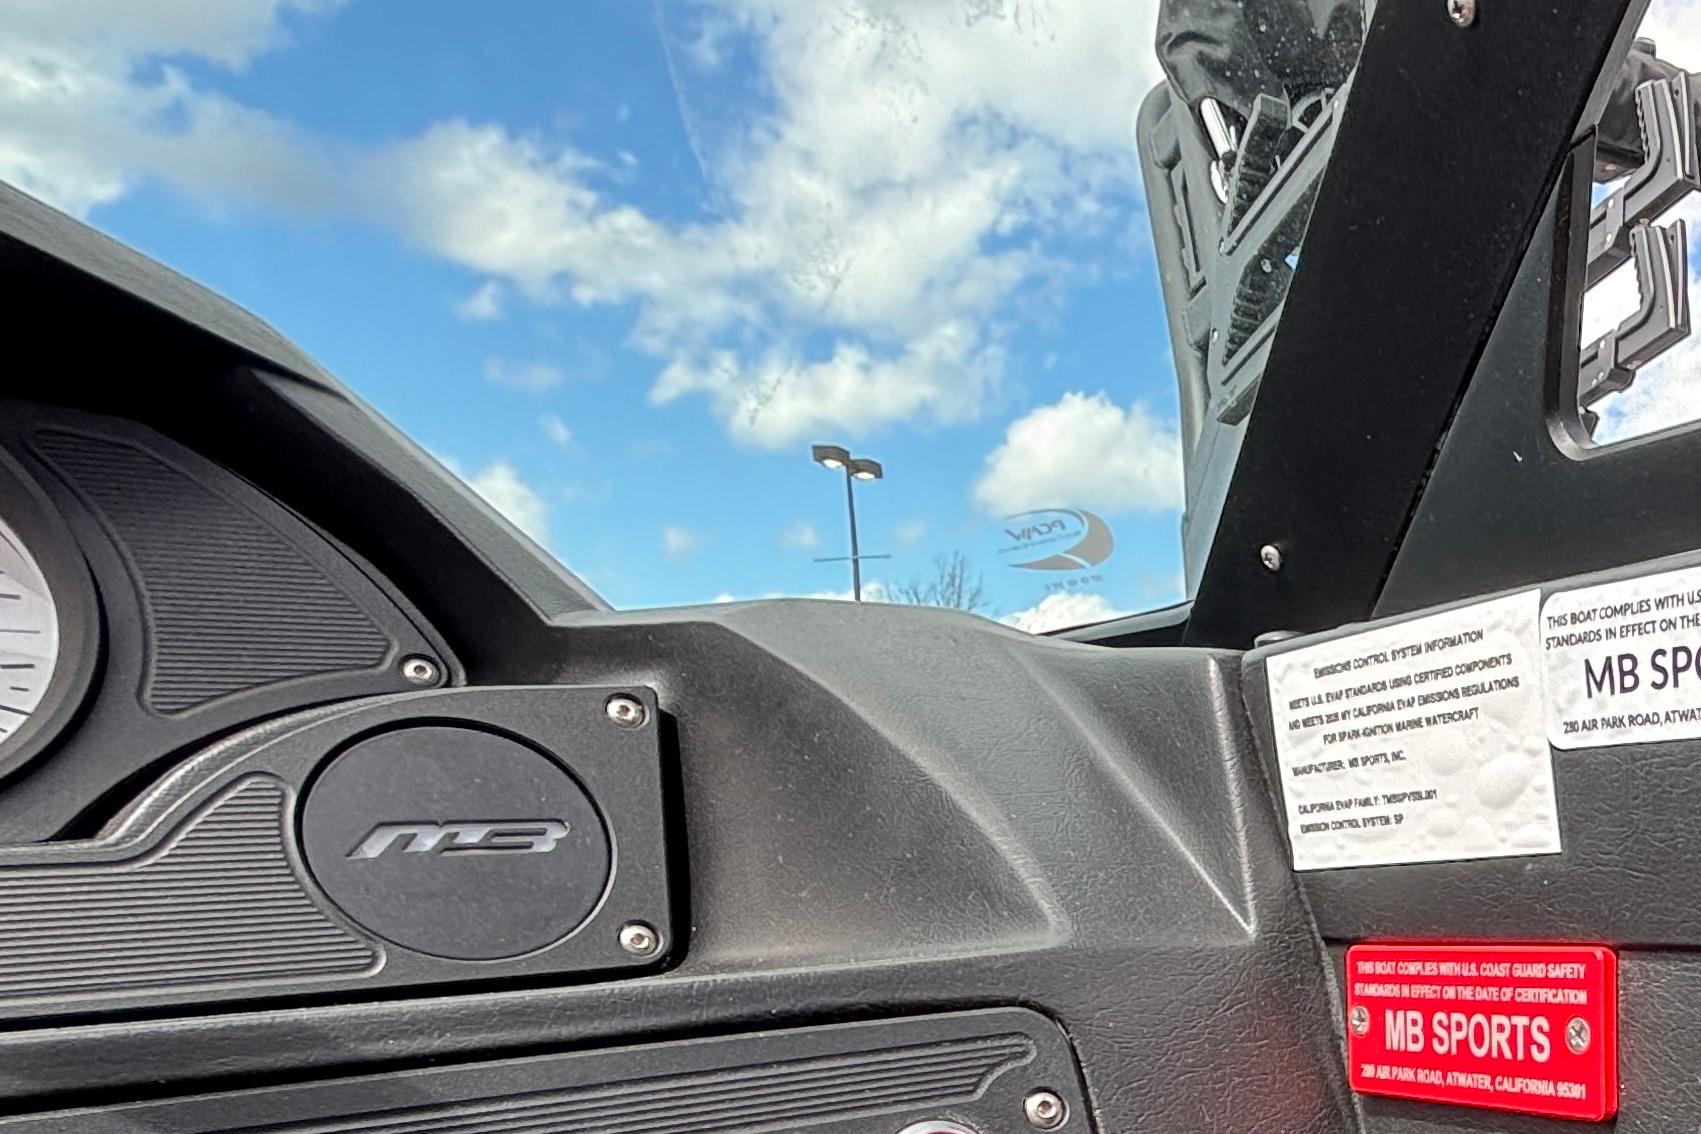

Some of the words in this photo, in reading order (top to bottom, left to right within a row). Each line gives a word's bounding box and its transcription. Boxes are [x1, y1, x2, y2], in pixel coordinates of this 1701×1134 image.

[1547, 613, 1568, 629] THIS
[1570, 608, 1598, 624] BOAT
[1599, 599, 1651, 620] COMPLIES
[1655, 593, 1684, 611] WITH
[1353, 651, 1389, 669] CONTROL
[1391, 643, 1422, 661] SYSTEM
[1424, 629, 1484, 653] INFORMATION
[1546, 629, 1602, 650] STANDARDS
[1605, 627, 1617, 640] IN
[1619, 620, 1657, 639] EFFECT
[1659, 616, 1677, 633] ON
[1679, 612, 1701, 629] THE
[1325, 689, 1344, 703] EVAP
[1345, 680, 1387, 699] STANDARDS
[1389, 675, 1412, 690] USING
[1414, 666, 1453, 684] CERTIFIED
[1455, 653, 1512, 676] COMPONENTS
[1584, 652, 1640, 699] MB
[1353, 701, 1395, 718] CALIFORNIA
[1397, 696, 1415, 710] EVAP
[1418, 688, 1460, 706] EMISSIONS
[1461, 676, 1519, 697] REGULATIONS
[1323, 733, 1336, 745] FOR
[1425, 707, 1479, 726] WATERCRAFT
[1581, 717, 1599, 732] AIR
[1601, 714, 1626, 730] PARK
[1628, 711, 1663, 728] ROAD,
[1331, 819, 1361, 831] CONTROL
[1375, 961, 1397, 975] BOAT
[1397, 961, 1438, 976] COMPLIES
[1438, 961, 1461, 976] WITH
[1480, 962, 1512, 977] COAST
[1512, 963, 1546, 978] GUARD
[1547, 963, 1586, 979] SAFETY
[1354, 982, 1400, 997] STANDARDS
[1410, 984, 1442, 999] EFFECT
[1442, 985, 1457, 999] ON
[1457, 985, 1475, 1000] THE
[1475, 986, 1500, 1001] DATE
[1500, 986, 1514, 1002] OF
[1514, 987, 1588, 1005] CERTIFICATION
[1384, 1008, 1424, 1053] MB
[1431, 1011, 1551, 1063] SPORTS
[1376, 1065, 1391, 1080] AIR
[1391, 1066, 1416, 1082] PARK
[1417, 1068, 1445, 1088] ROAD,
[1446, 1071, 1493, 1092] ATWATER,
[1495, 1076, 1556, 1097] CALIFORNIA
